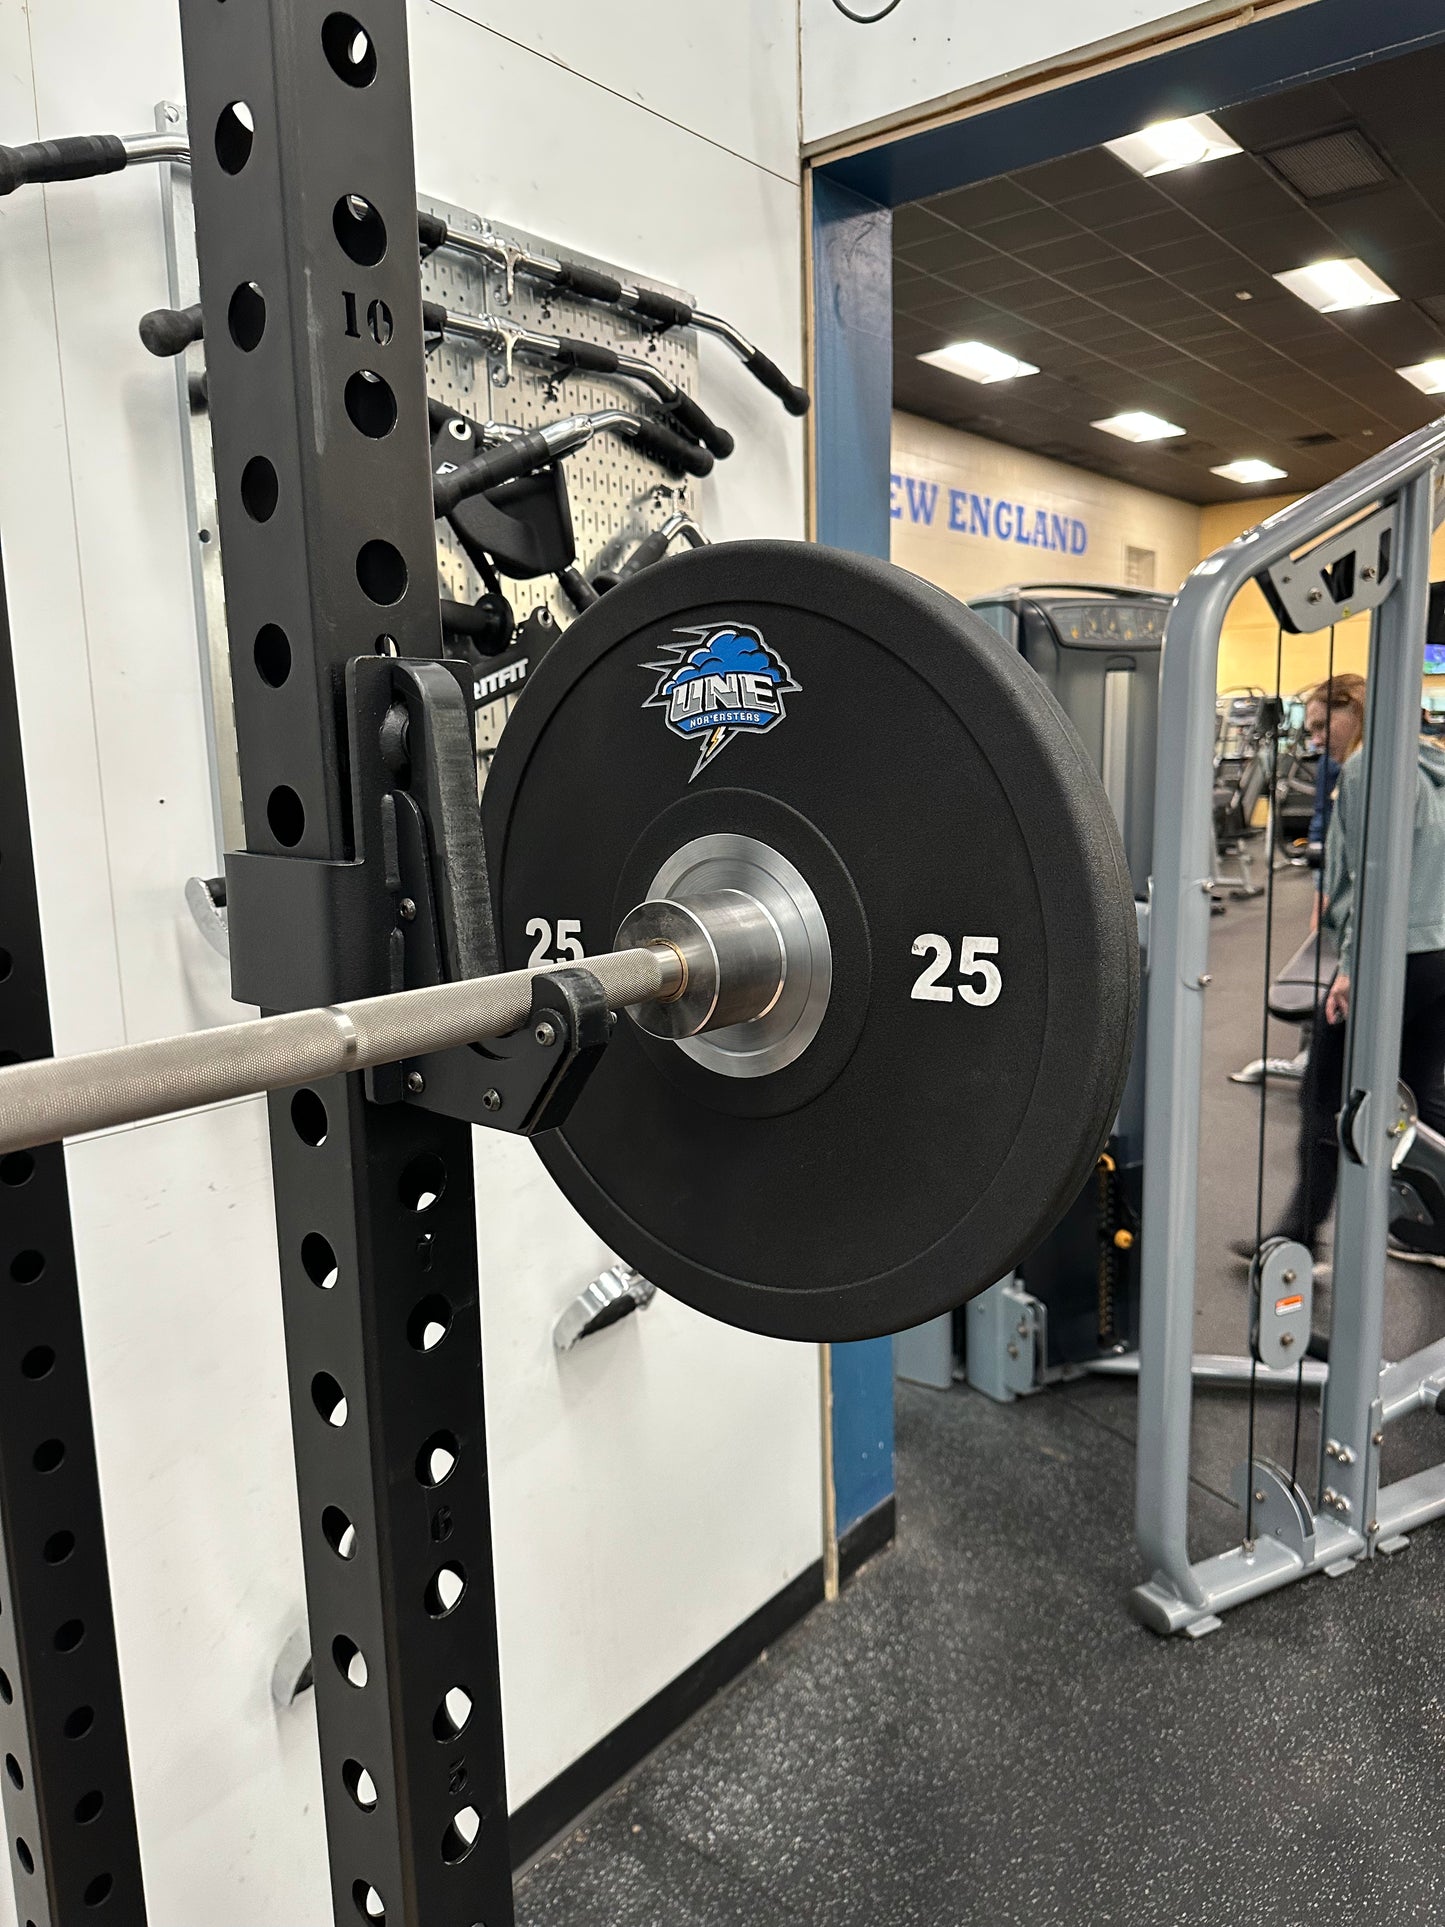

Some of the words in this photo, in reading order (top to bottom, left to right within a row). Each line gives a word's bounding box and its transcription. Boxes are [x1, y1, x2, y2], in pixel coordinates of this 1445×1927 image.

[342, 291, 393, 345] 10
[890, 474, 938, 526] EW
[948, 488, 1088, 556] ENGLAND
[670, 673, 780, 722] UNE
[690, 711, 760, 728] NOR'EASTERS
[525, 917, 584, 969] 25
[910, 933, 1002, 1007] 25
